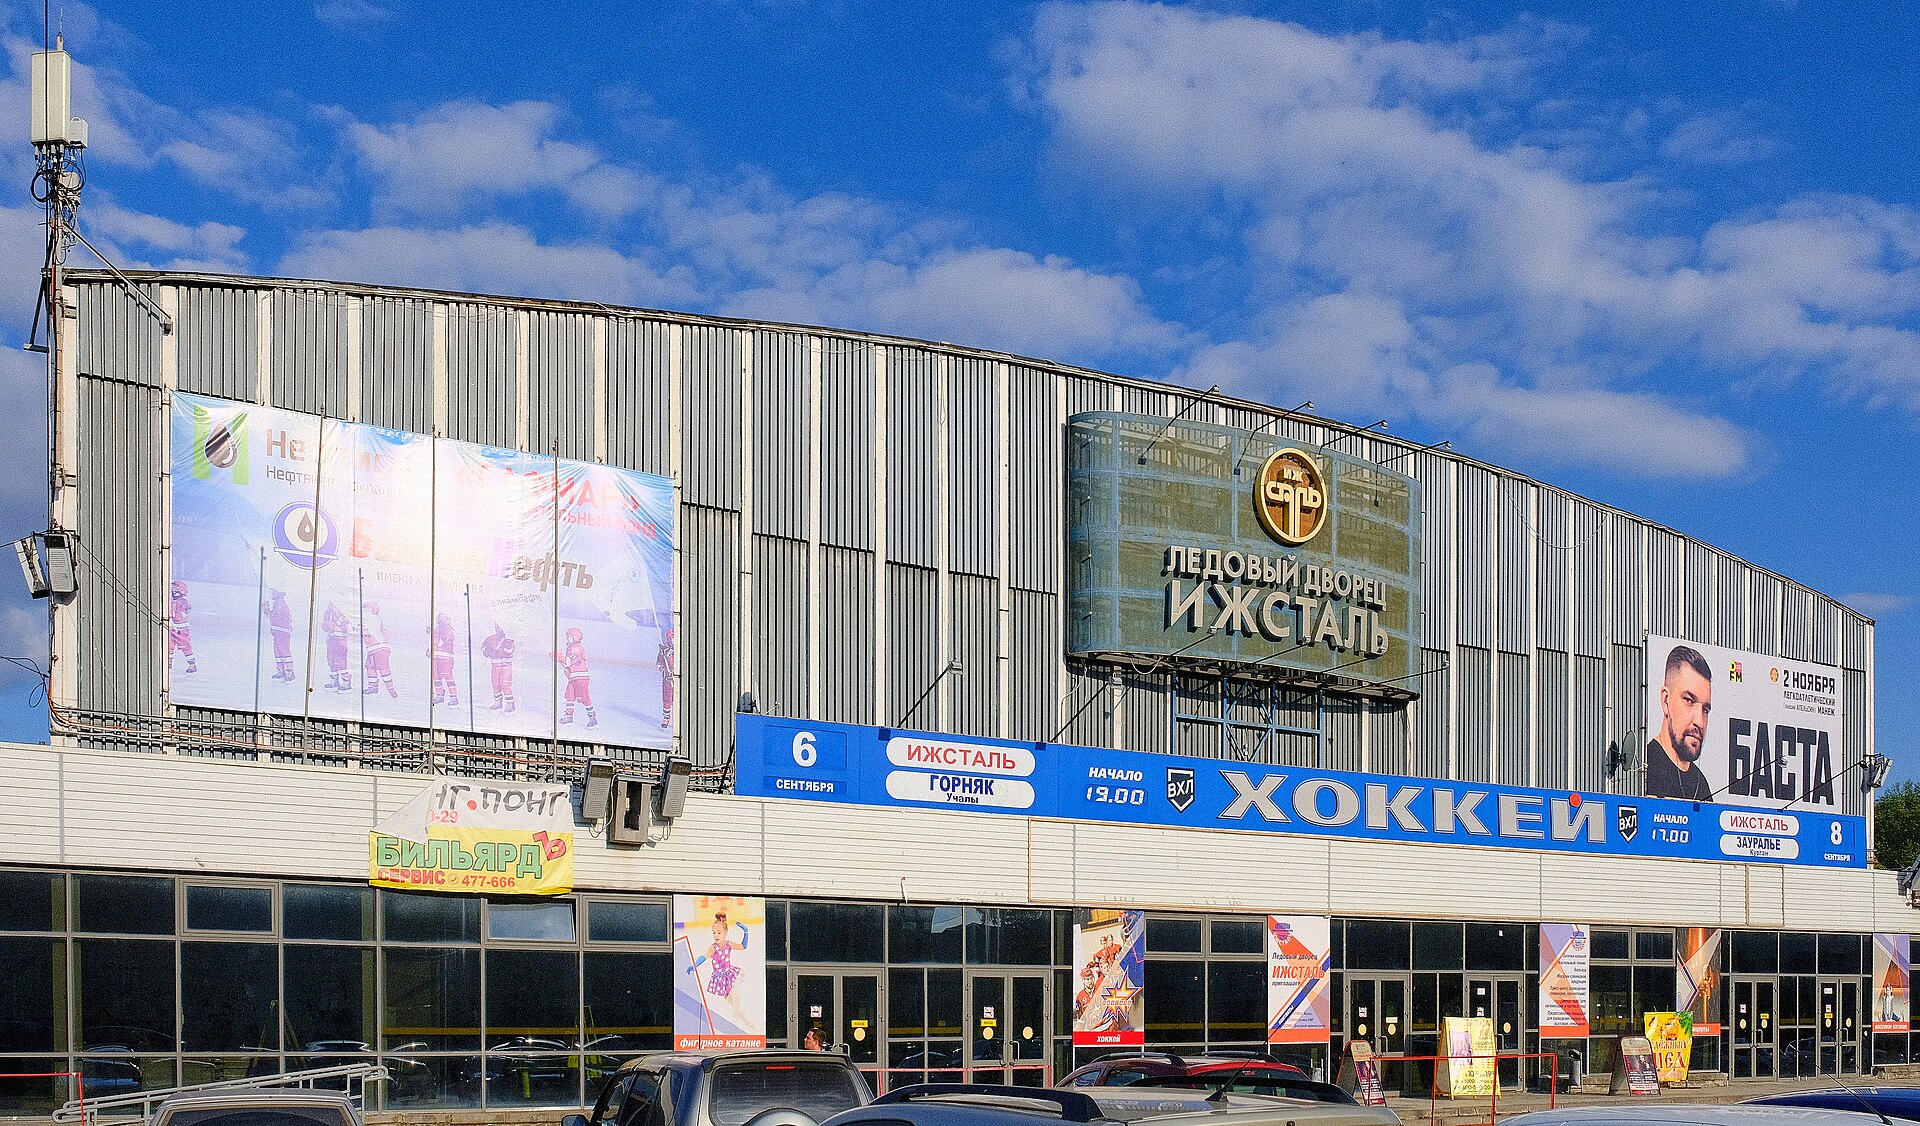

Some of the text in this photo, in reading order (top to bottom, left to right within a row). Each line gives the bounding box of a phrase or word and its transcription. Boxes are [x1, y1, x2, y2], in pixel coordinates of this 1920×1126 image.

[1167, 545, 1387, 611] ЛЕДОВЫЙ ДВОРЕЦ
[1170, 579, 1389, 658] ИЖСТАЛЬ
[1783, 669, 1836, 695] 2 НОЯБРЯ
[1783, 690, 1836, 707] ЛЕГКОАТЛЕТИЧЕСКИЙ
[1817, 706, 1836, 716] МАНЕЖ
[792, 731, 817, 767] 6
[907, 744, 1016, 770] ИЖСТАЛЬ
[1728, 717, 1834, 806] БАСТА
[1088, 766, 1143, 782] НАЧАЛО
[776, 779, 834, 793] СЕНТЯБРЯ
[930, 774, 994, 796] ГОРНЯК
[1167, 778, 1194, 798] ВХЛ
[946, 793, 979, 804] Учалы
[1086, 786, 1145, 806] 19.00
[1217, 769, 1607, 844] ХОККЕЙ
[1619, 814, 1637, 831] ВХЛ
[1653, 813, 1689, 825] НАЧАЛО
[1730, 816, 1789, 831] ИЖСТАЛЬ
[1651, 828, 1689, 844] 17.00
[1830, 820, 1843, 846] 8
[1736, 836, 1781, 851] ЗАУРАЛЬЕ
[1750, 849, 1769, 857] Курган
[1823, 853, 1851, 862] СЕНТЯБРЯ
[378, 868, 516, 888] СЕРВИС 477-666
[1272, 952, 1318, 962] Ледовый дворец
[1272, 965, 1325, 979] ИЖСТАЛЬ
[680, 1038, 761, 1049] фигурное катание
[1097, 1034, 1121, 1043] хоккей
